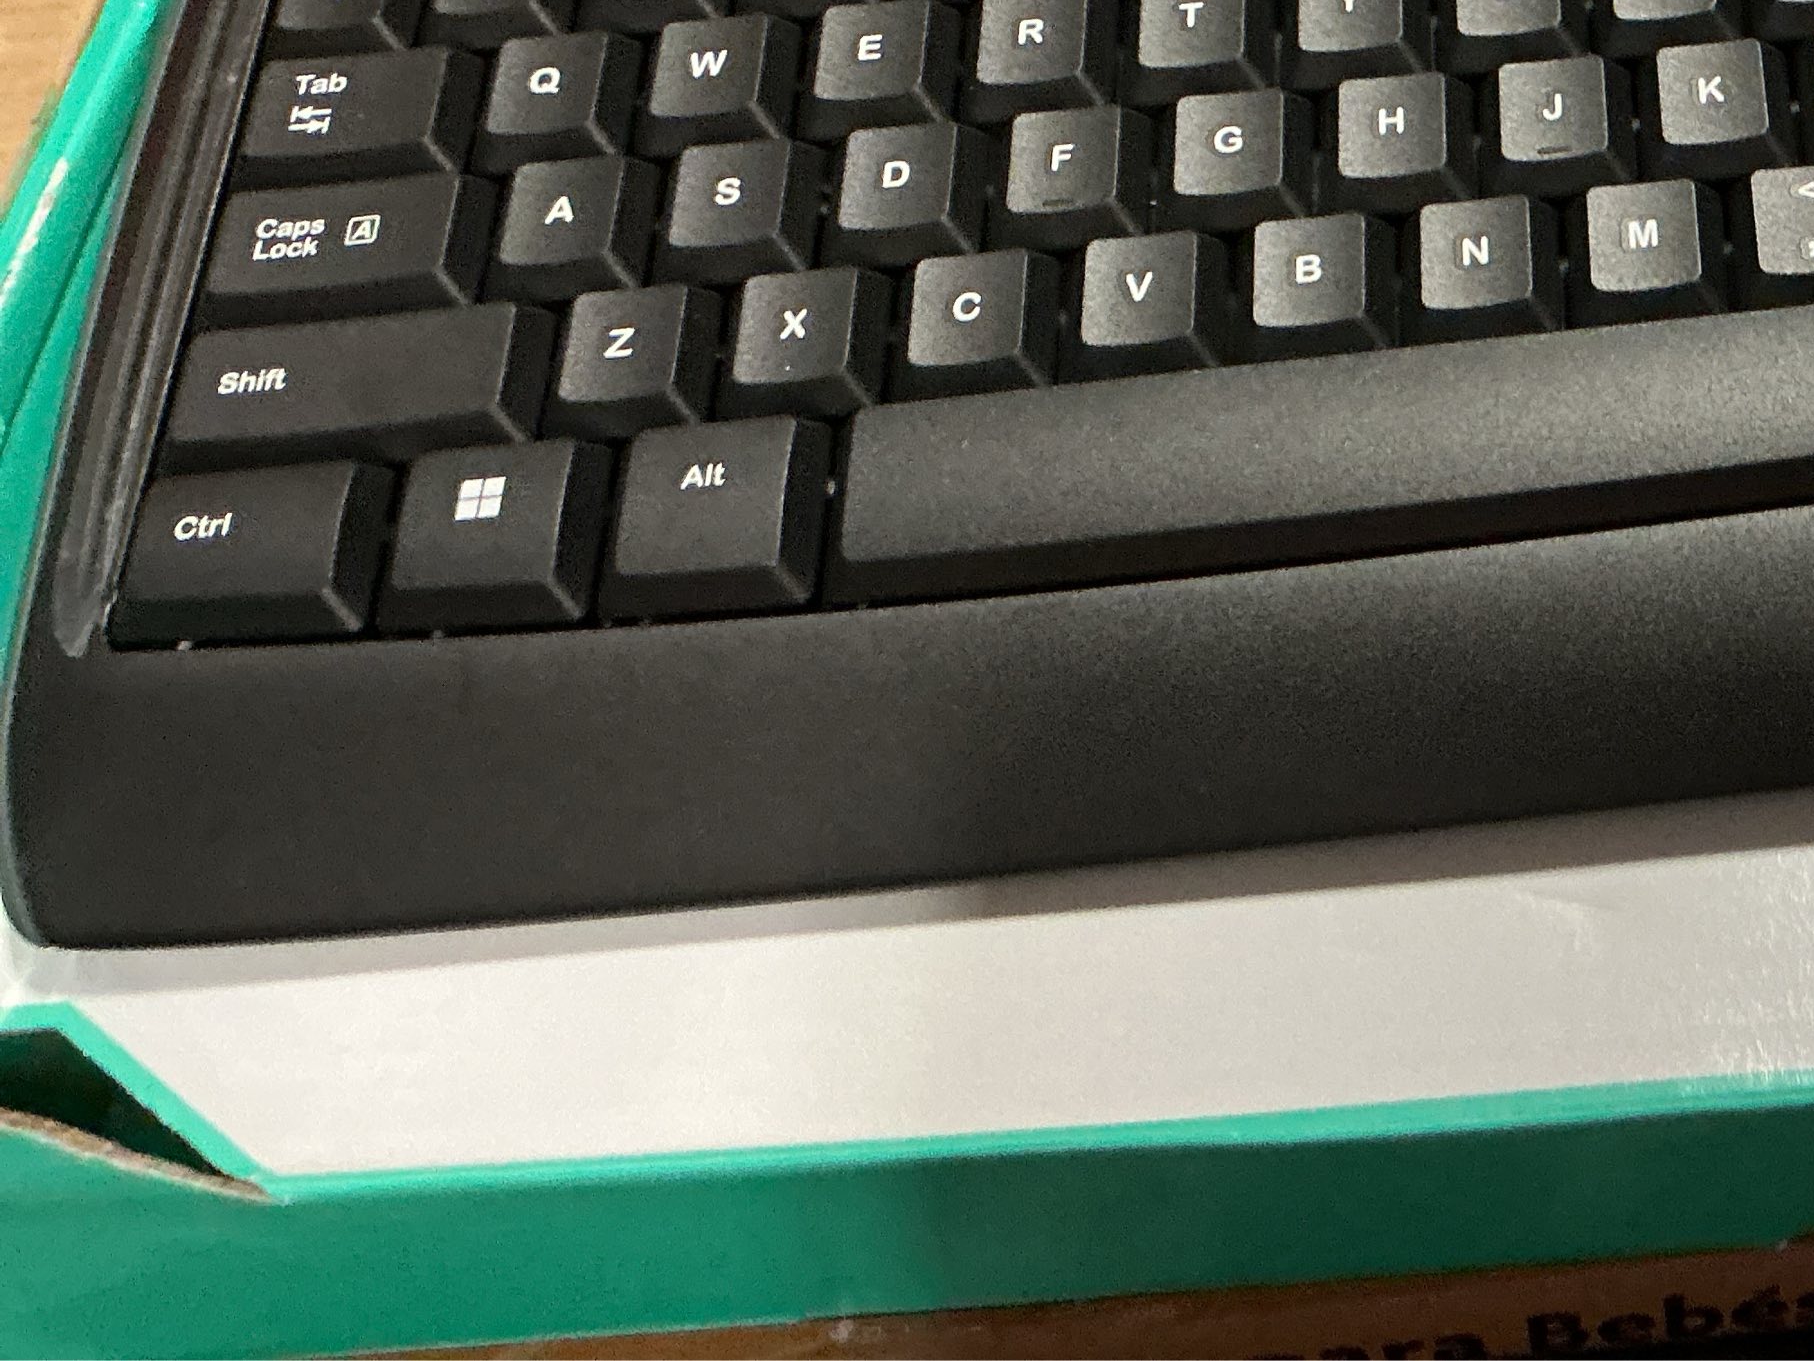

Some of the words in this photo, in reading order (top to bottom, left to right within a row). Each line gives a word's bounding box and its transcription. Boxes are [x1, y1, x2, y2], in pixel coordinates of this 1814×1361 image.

[1178, 1, 1204, 28] T
[1017, 18, 1044, 45] R
[857, 34, 883, 61] E
[690, 49, 728, 79] W
[295, 72, 348, 96] Tab
[529, 67, 561, 94] Q
[1697, 75, 1725, 104] K
[1378, 106, 1405, 136] H
[1542, 93, 1563, 121] J
[1213, 125, 1243, 154] G
[1051, 143, 1074, 172] F
[882, 160, 911, 189] D
[714, 177, 741, 206] S
[544, 195, 575, 225] A
[255, 217, 326, 240] Caps
[1628, 219, 1659, 249] M
[252, 237, 318, 261] Lock
[1462, 235, 1489, 266] N
[1295, 254, 1322, 284] B
[1125, 271, 1153, 302] V
[952, 291, 982, 322] C
[779, 308, 808, 340] X
[603, 327, 635, 359] Z
[217, 368, 287, 395] Shift
[680, 462, 726, 490] Alt
[173, 512, 233, 541] Ctrl
